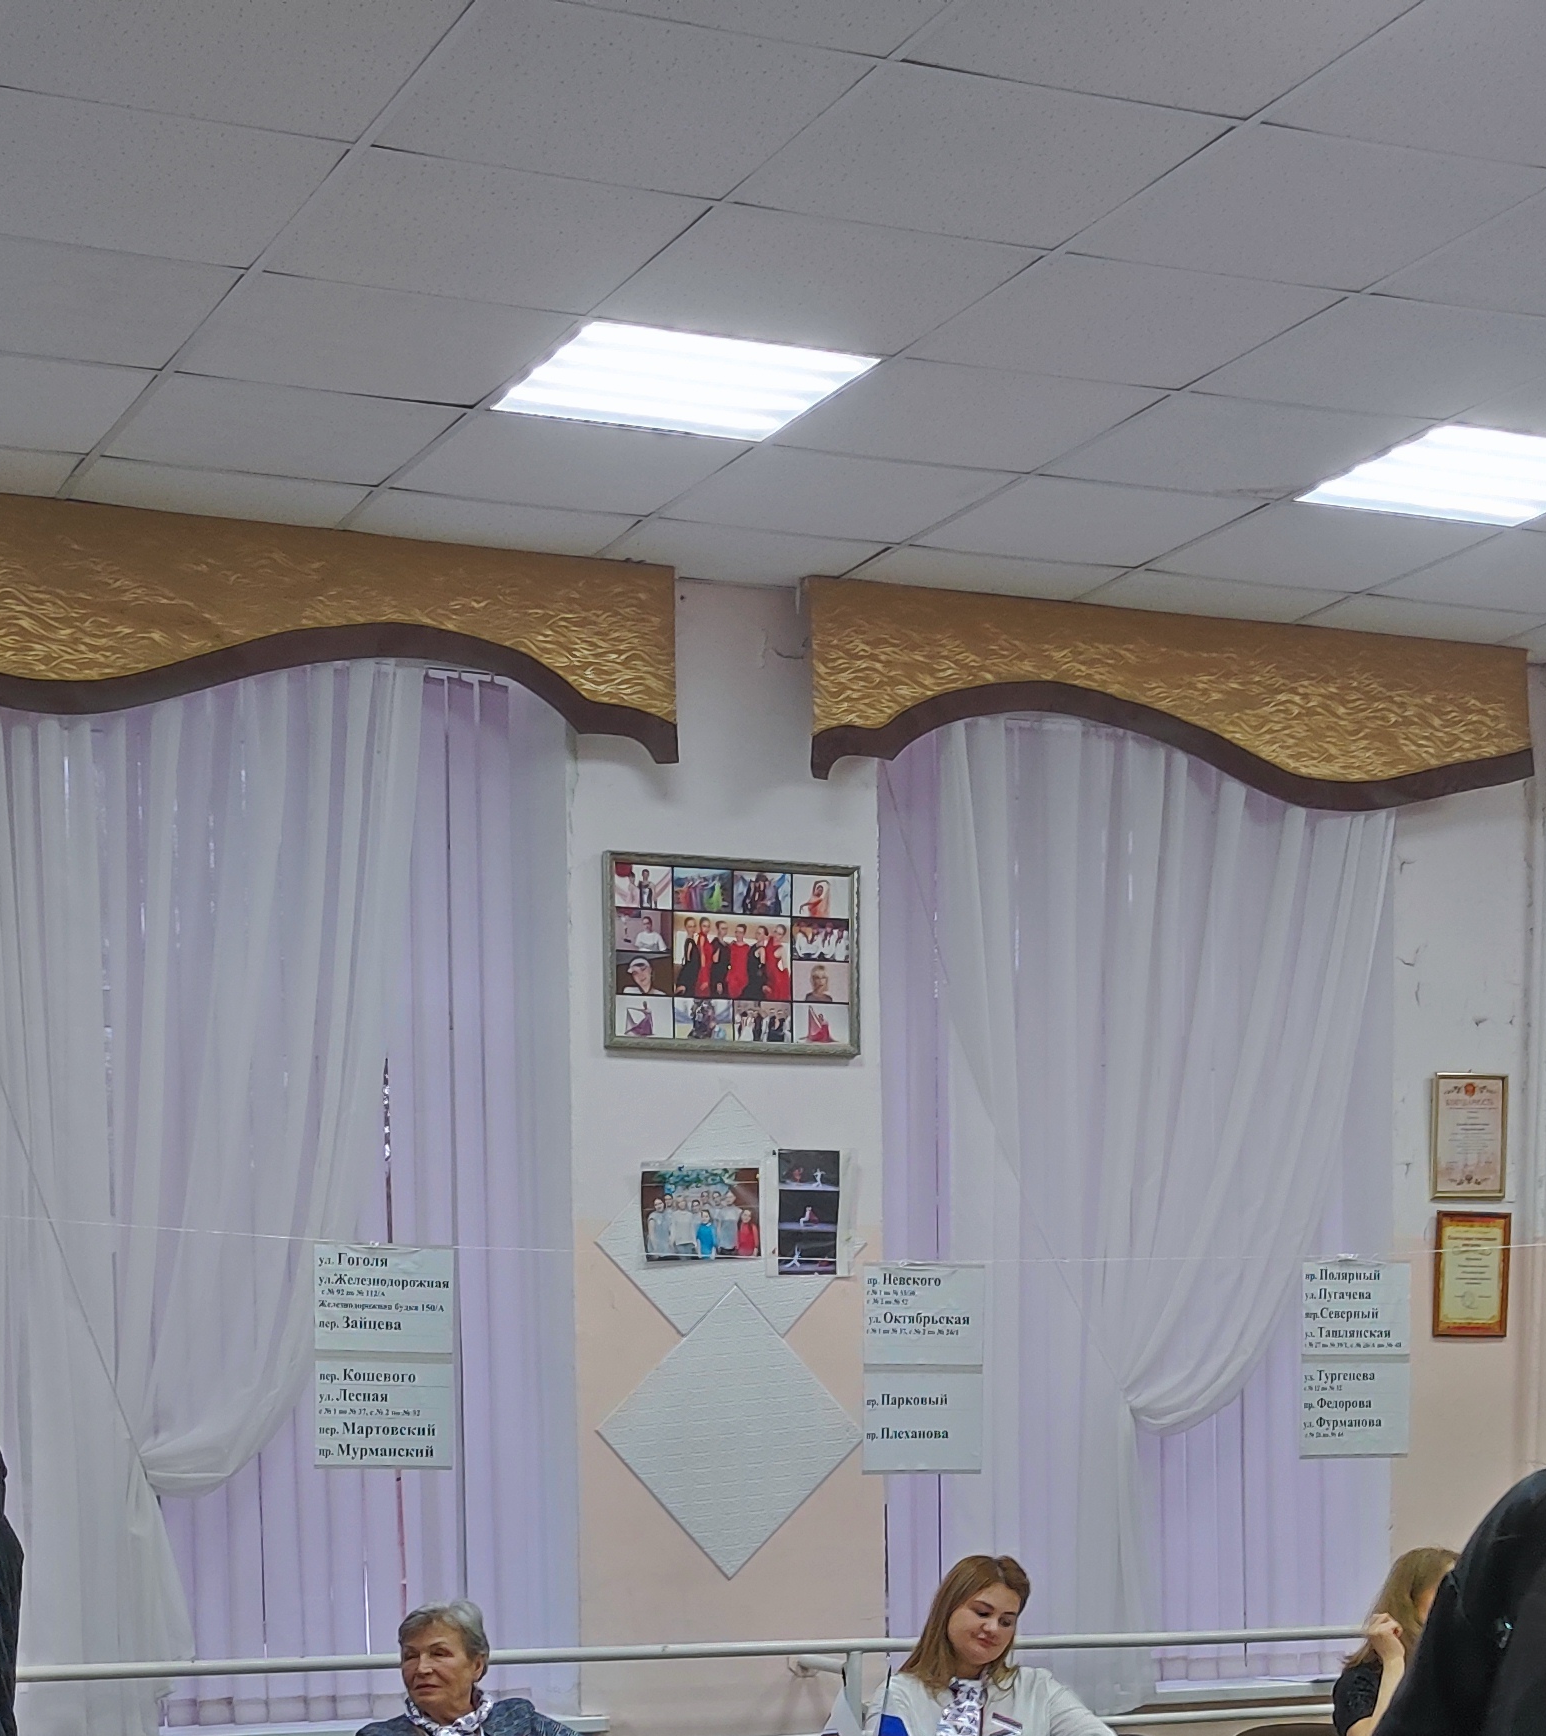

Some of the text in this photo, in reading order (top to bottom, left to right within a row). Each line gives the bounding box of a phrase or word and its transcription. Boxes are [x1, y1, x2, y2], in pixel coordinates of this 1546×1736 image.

[337, 1252, 388, 1267] Гоголя
[883, 1272, 941, 1286] Невского
[1319, 1268, 1381, 1284] Полярный
[1319, 1287, 1372, 1302] Пугачева
[342, 1316, 402, 1332] Зайцева
[883, 1311, 970, 1327] Октябрьская
[343, 1368, 416, 1383] Кошевого
[1316, 1369, 1375, 1384] Тургенева
[335, 1388, 388, 1403] Лесная
[881, 1393, 948, 1409] Парковый
[1316, 1397, 1372, 1412] Федорова
[342, 1422, 436, 1438] Мартовский
[1316, 1416, 1382, 1431] Фурманова
[881, 1427, 949, 1440] Плеханова
[337, 1443, 434, 1460] Мурманский
